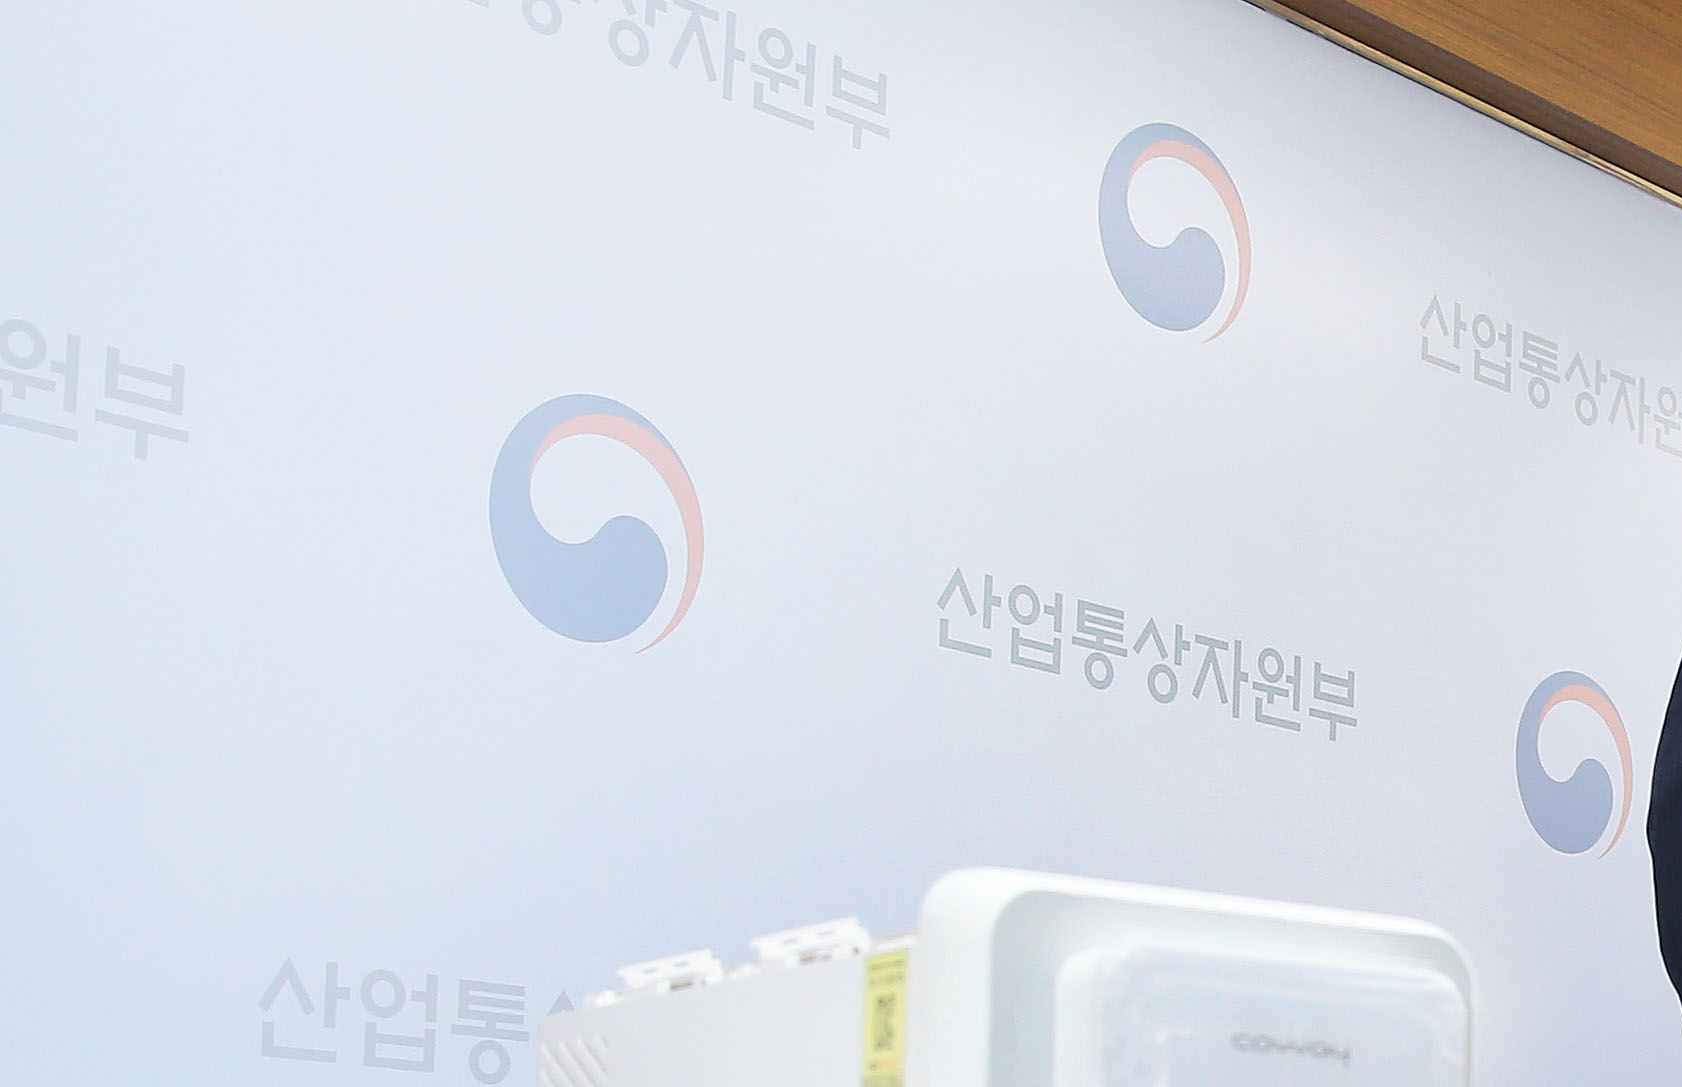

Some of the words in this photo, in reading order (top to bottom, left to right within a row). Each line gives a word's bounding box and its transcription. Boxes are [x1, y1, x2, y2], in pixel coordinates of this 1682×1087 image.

[468, 0, 890, 150] 상자원부
[937, 567, 1358, 742] 산업통상자원부
[257, 957, 576, 1085] 산업통
